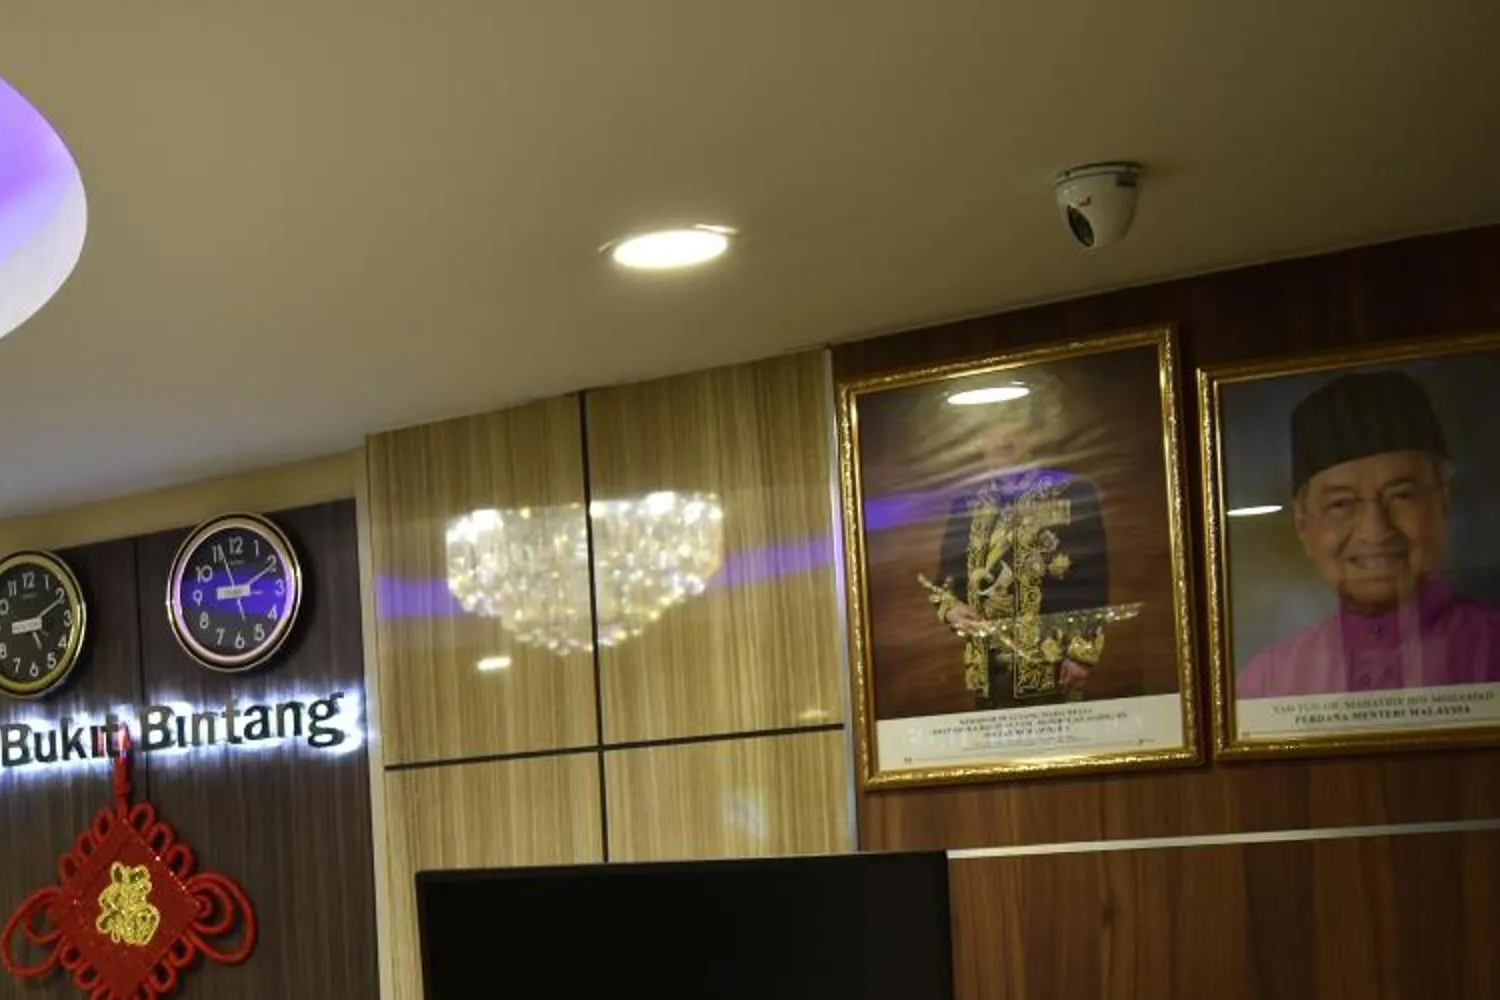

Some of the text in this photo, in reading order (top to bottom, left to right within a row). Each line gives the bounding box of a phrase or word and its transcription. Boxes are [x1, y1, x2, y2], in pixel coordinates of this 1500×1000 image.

[228, 536, 243, 555] 12
[253, 540, 260, 557] 1
[195, 565, 213, 583] 10
[275, 579, 285, 596] 3
[192, 590, 203, 606] 9
[200, 612, 209, 629] 8
[267, 604, 278, 621] 4
[216, 628, 226, 645] 7
[235, 632, 245, 649] 6
[254, 624, 265, 641] 5
[0, 712, 122, 768] Bukit
[139, 692, 345, 752] Bintang
